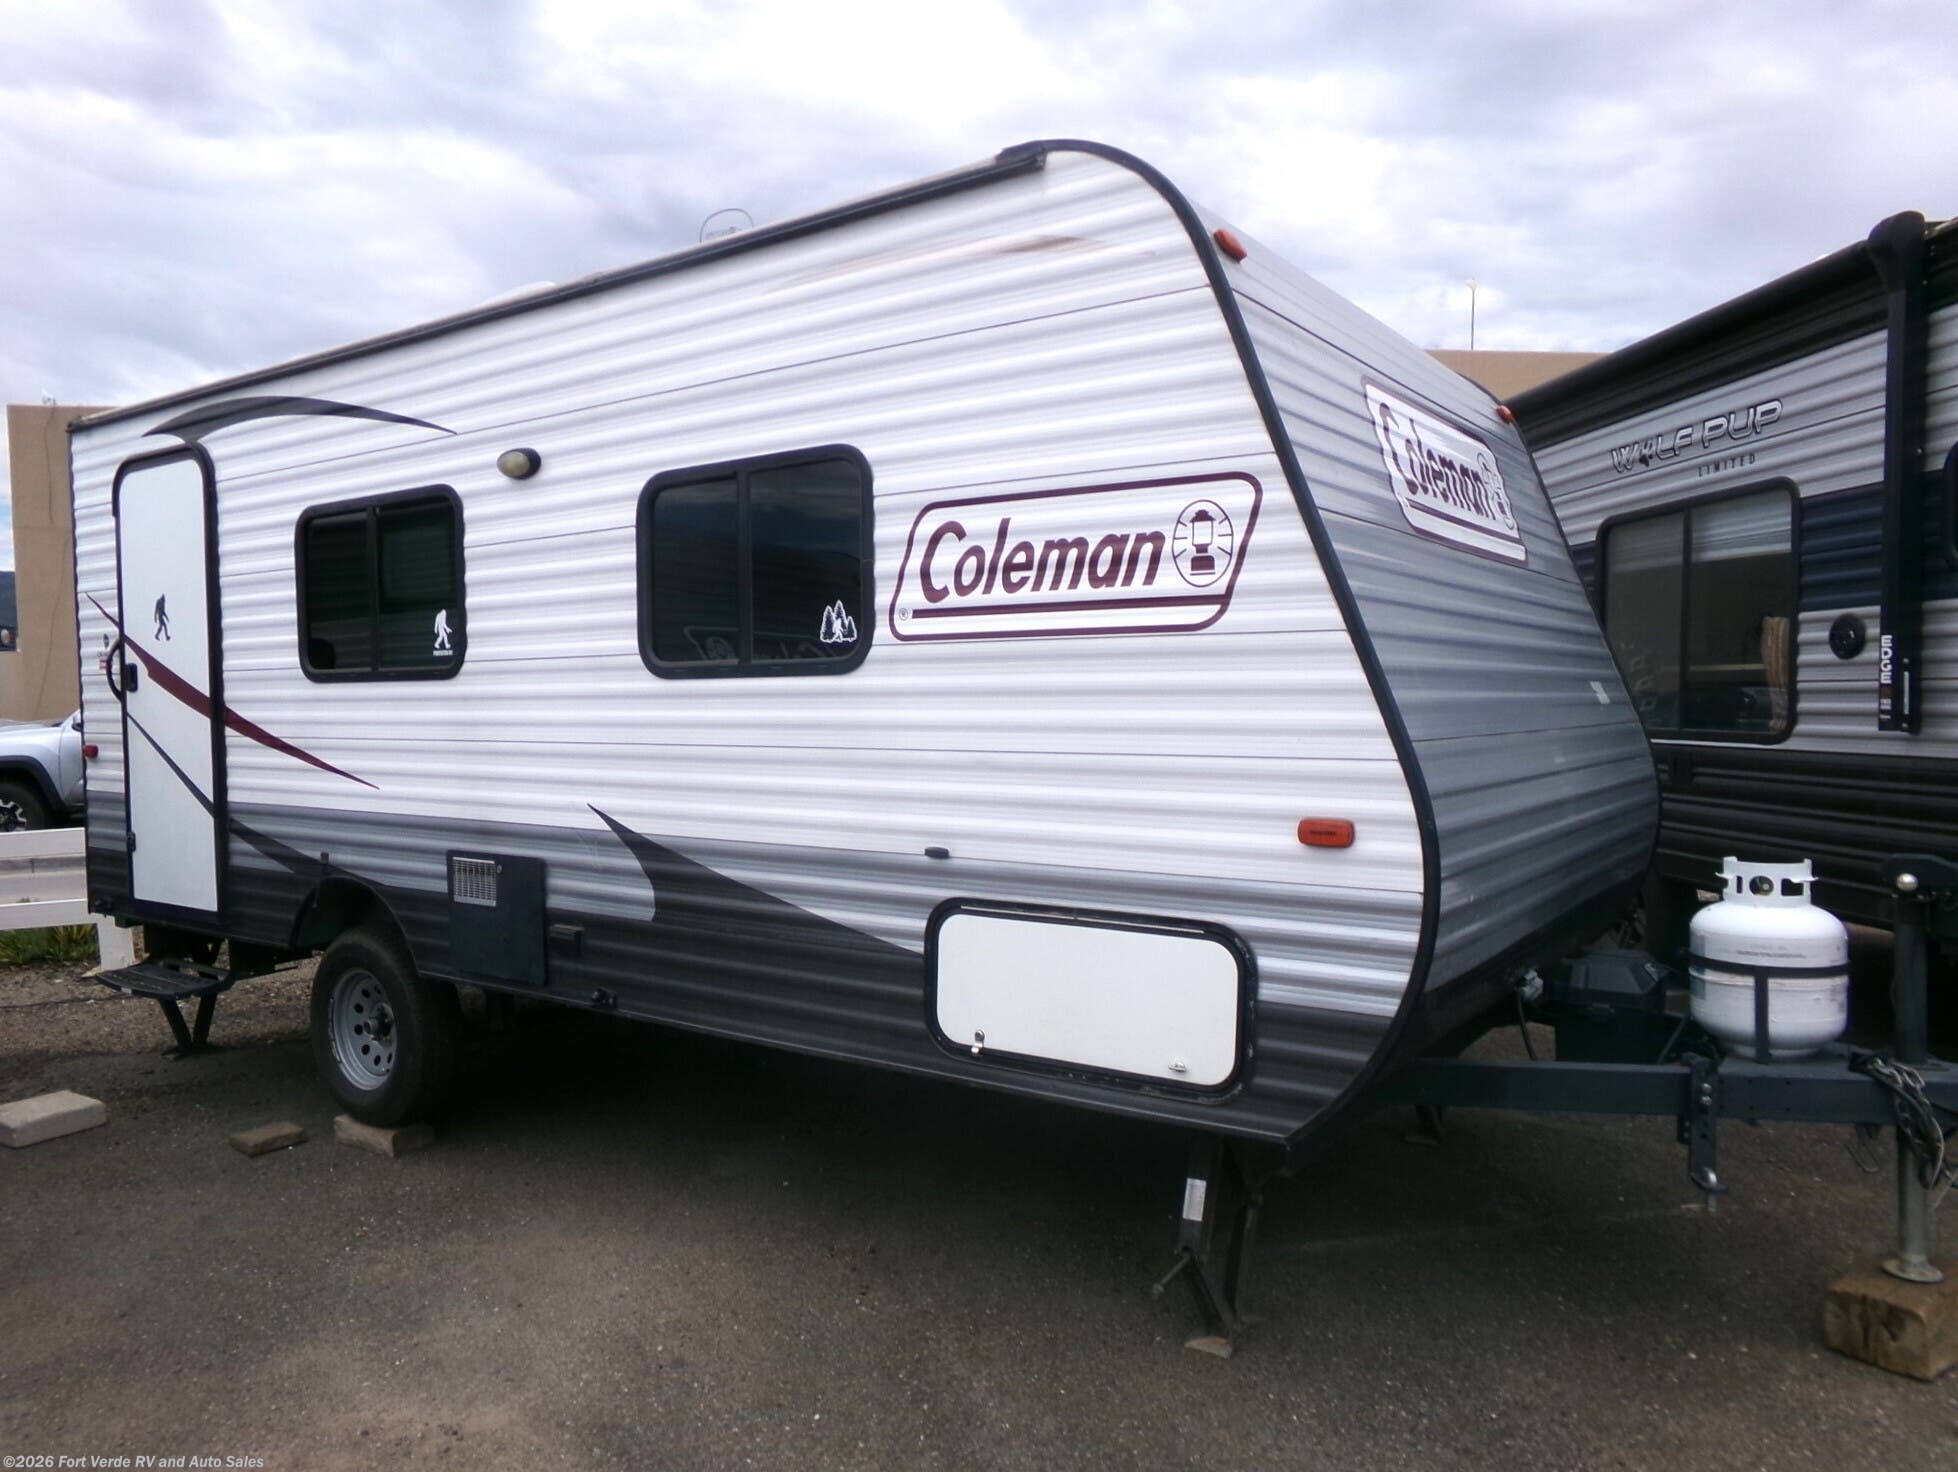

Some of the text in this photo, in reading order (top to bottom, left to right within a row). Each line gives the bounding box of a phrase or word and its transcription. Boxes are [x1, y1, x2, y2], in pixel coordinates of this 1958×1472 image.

[1702, 399, 1783, 449] PUP
[1380, 403, 1496, 520] Coleman
[1697, 452, 1756, 478] LIMITED
[920, 518, 1166, 603] Coleman
[1880, 634, 1893, 684] EDGE
